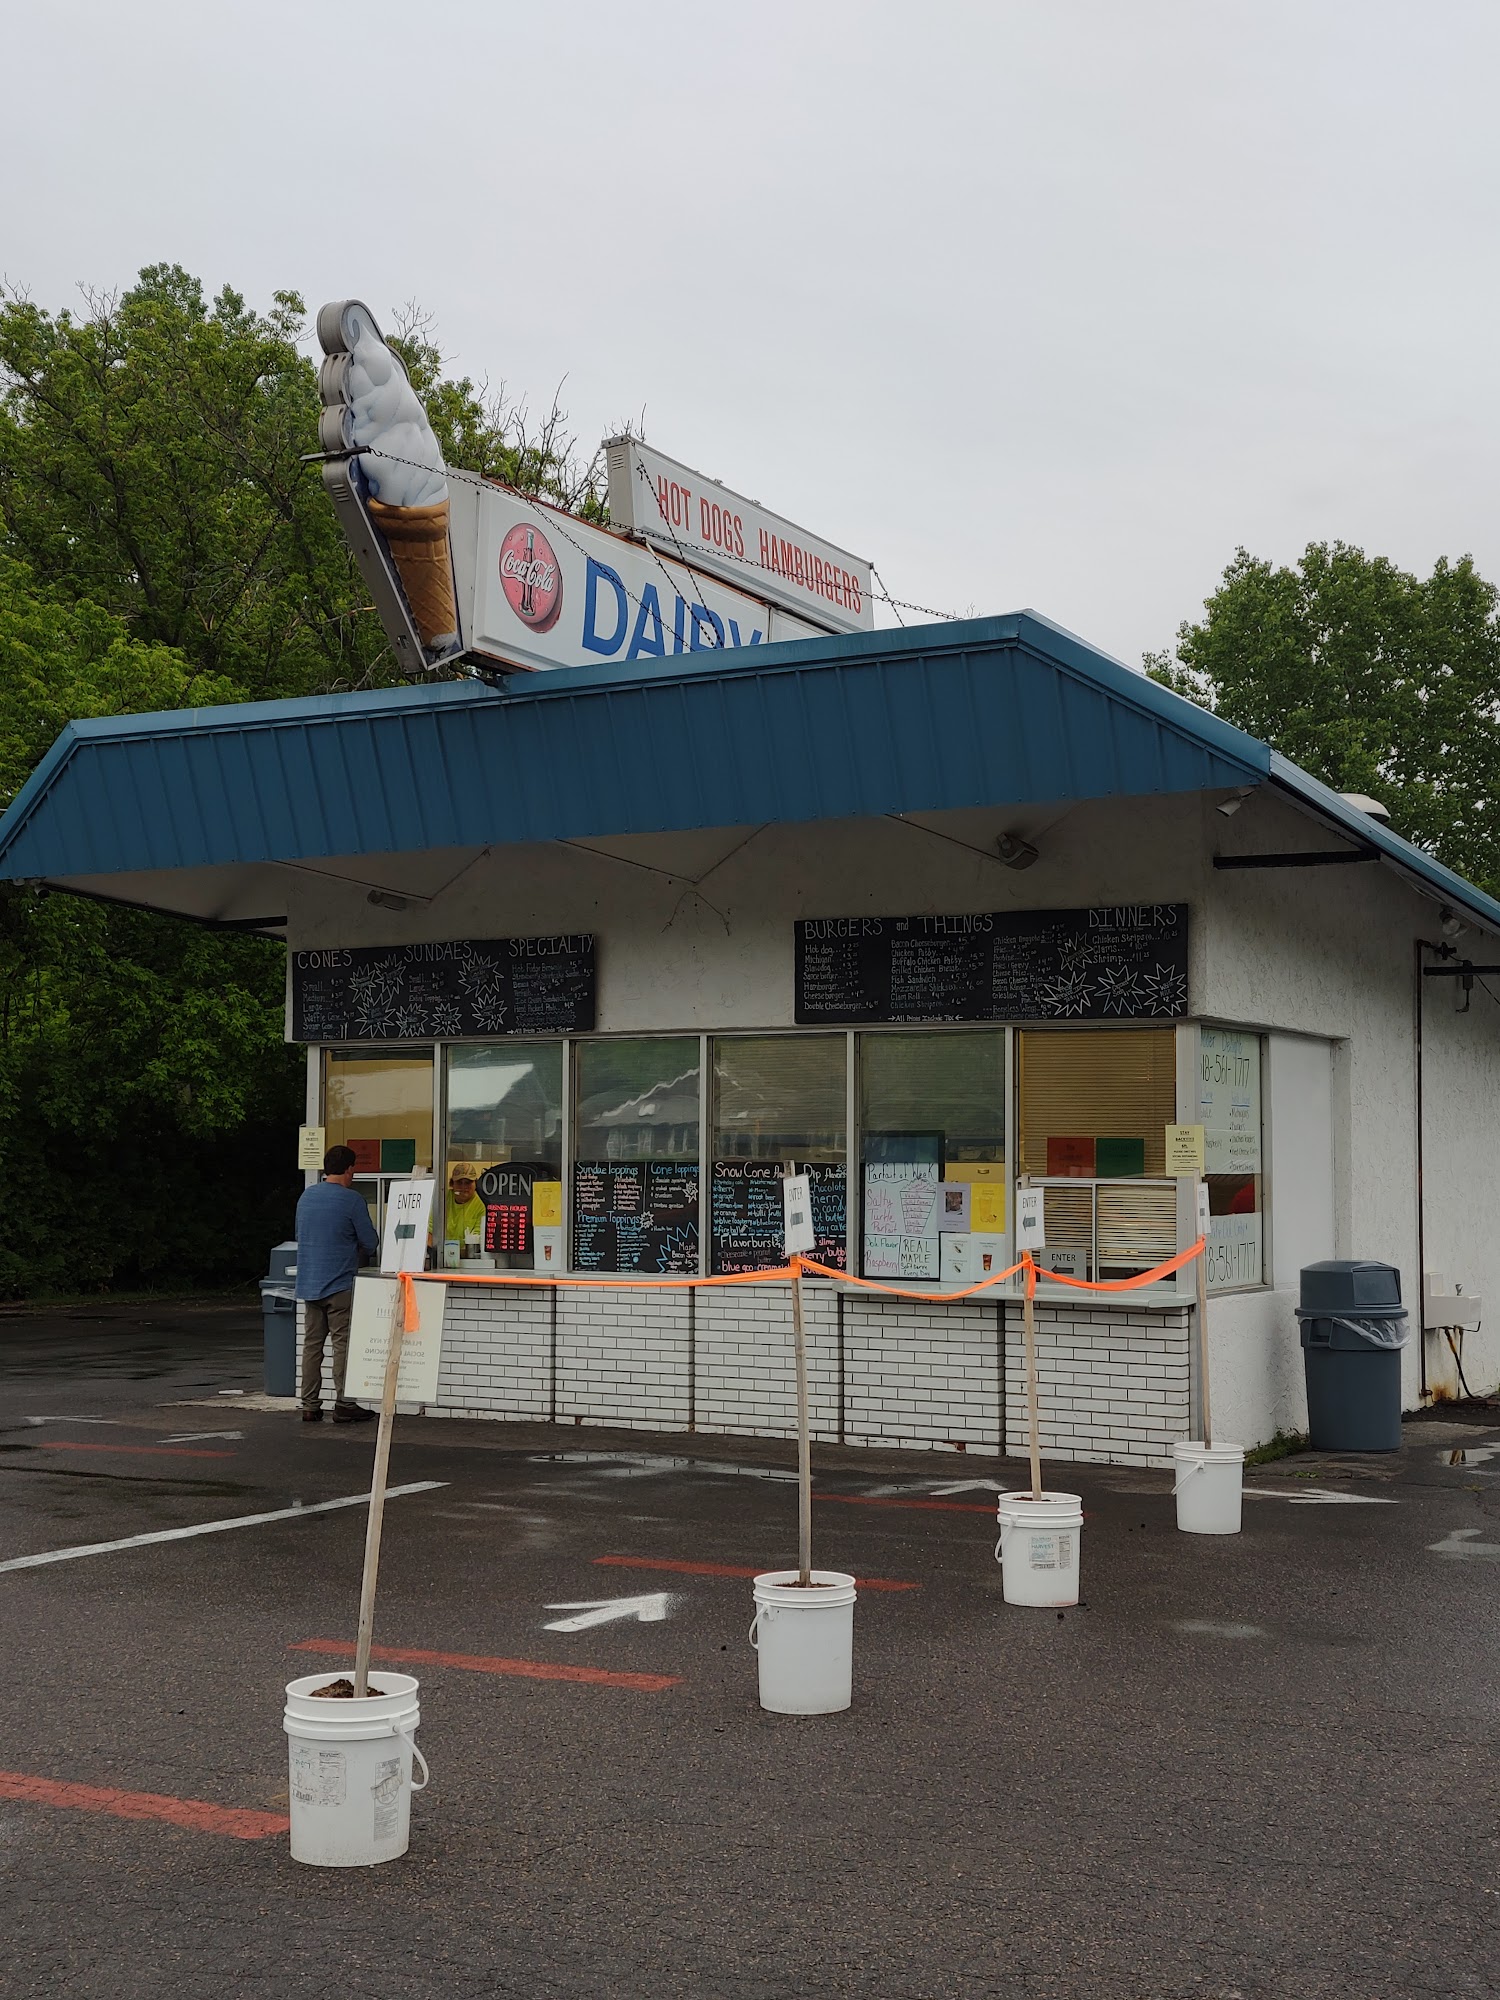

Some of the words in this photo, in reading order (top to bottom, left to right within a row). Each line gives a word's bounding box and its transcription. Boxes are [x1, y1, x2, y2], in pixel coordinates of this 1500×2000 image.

[657, 475, 691, 532] HOT
[699, 496, 745, 558] DOGS
[758, 527, 862, 615] HAMBURGERS
[1089, 905, 1177, 928] DINNERS
[805, 918, 883, 939] BURGERS
[896, 917, 909, 931] and
[917, 914, 993, 934] THINGS
[1092, 934, 1120, 945] Chicken
[297, 949, 353, 970] CONES
[404, 941, 472, 963] SUNDAES
[508, 934, 594, 957] SPECIALTY
[805, 944, 819, 954] Hot
[302, 980, 323, 992] Small
[1200, 1054, 1251, 1089] 18-561-1717
[576, 1161, 607, 1175] Sundae
[606, 1161, 640, 1179] Toppings
[651, 1161, 674, 1175] Cone
[714, 1161, 742, 1178] Snow
[743, 1161, 771, 1178] Cone
[803, 1163, 822, 1184] Dip
[866, 1162, 896, 1181] Parfait
[482, 1172, 532, 1197] OPEN
[397, 1192, 422, 1210] ENTER
[788, 1185, 804, 1203] ENTER
[866, 1188, 894, 1209] Salty
[1022, 1196, 1037, 1209] ENTER
[576, 1210, 607, 1223] Premium
[606, 1211, 641, 1229] Toppings
[867, 1208, 896, 1223] Turtle
[871, 1220, 898, 1235] Parfait
[720, 1234, 777, 1249] Flavorburst
[818, 1237, 836, 1247] slime
[903, 1238, 931, 1253] REAL
[721, 1260, 740, 1272] blue
[900, 1253, 932, 1264] MAPLE
[1051, 1253, 1076, 1262] ENTER
